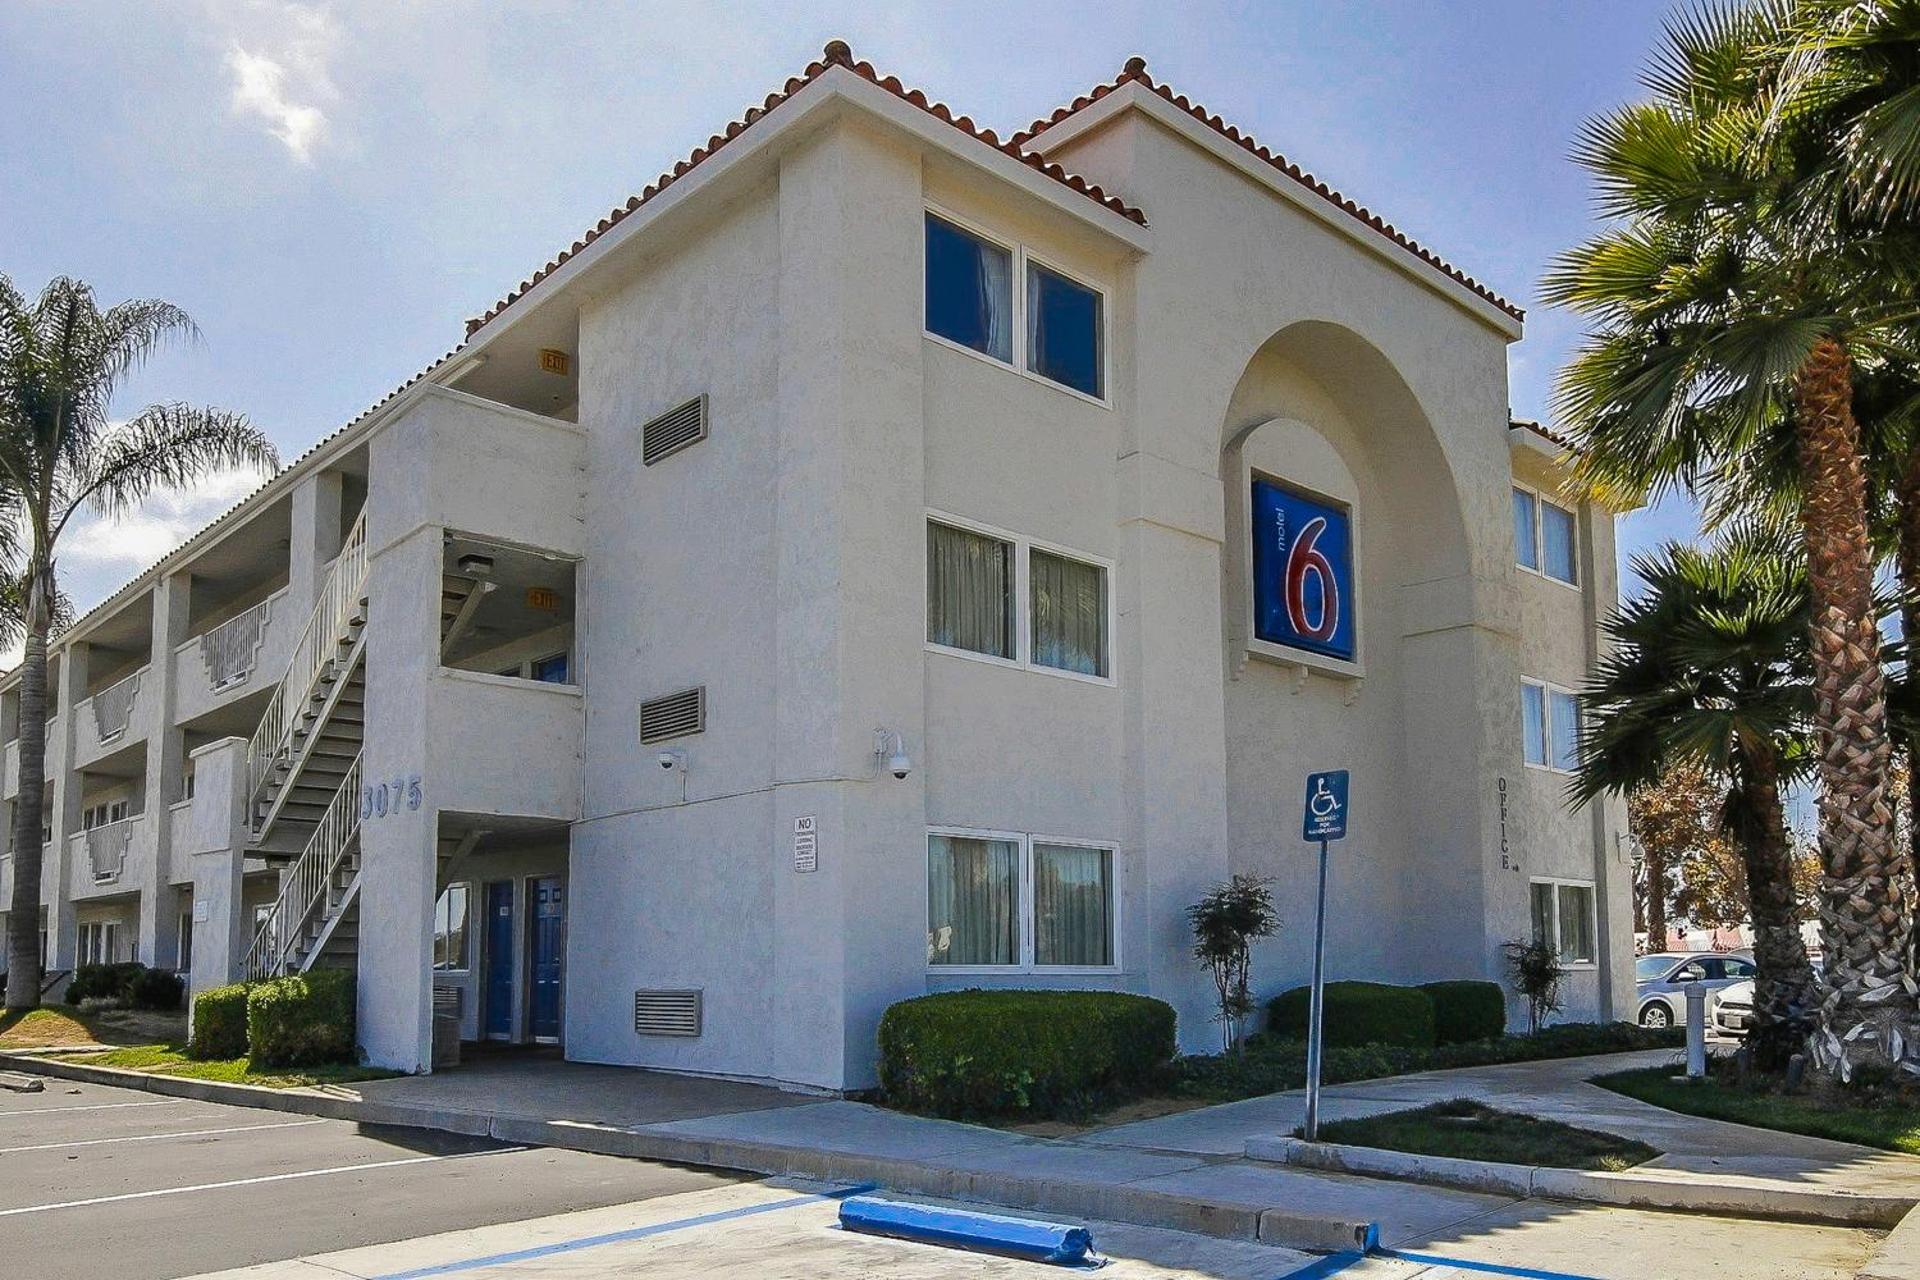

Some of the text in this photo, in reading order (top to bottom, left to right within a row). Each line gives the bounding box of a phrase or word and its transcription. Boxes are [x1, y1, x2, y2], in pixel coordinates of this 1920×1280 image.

[1275, 507, 1286, 552] motel
[1285, 516, 1340, 642] 6
[361, 777, 423, 820] 3075
[798, 818, 811, 829] NO
[1498, 777, 1509, 870] OFFICE
